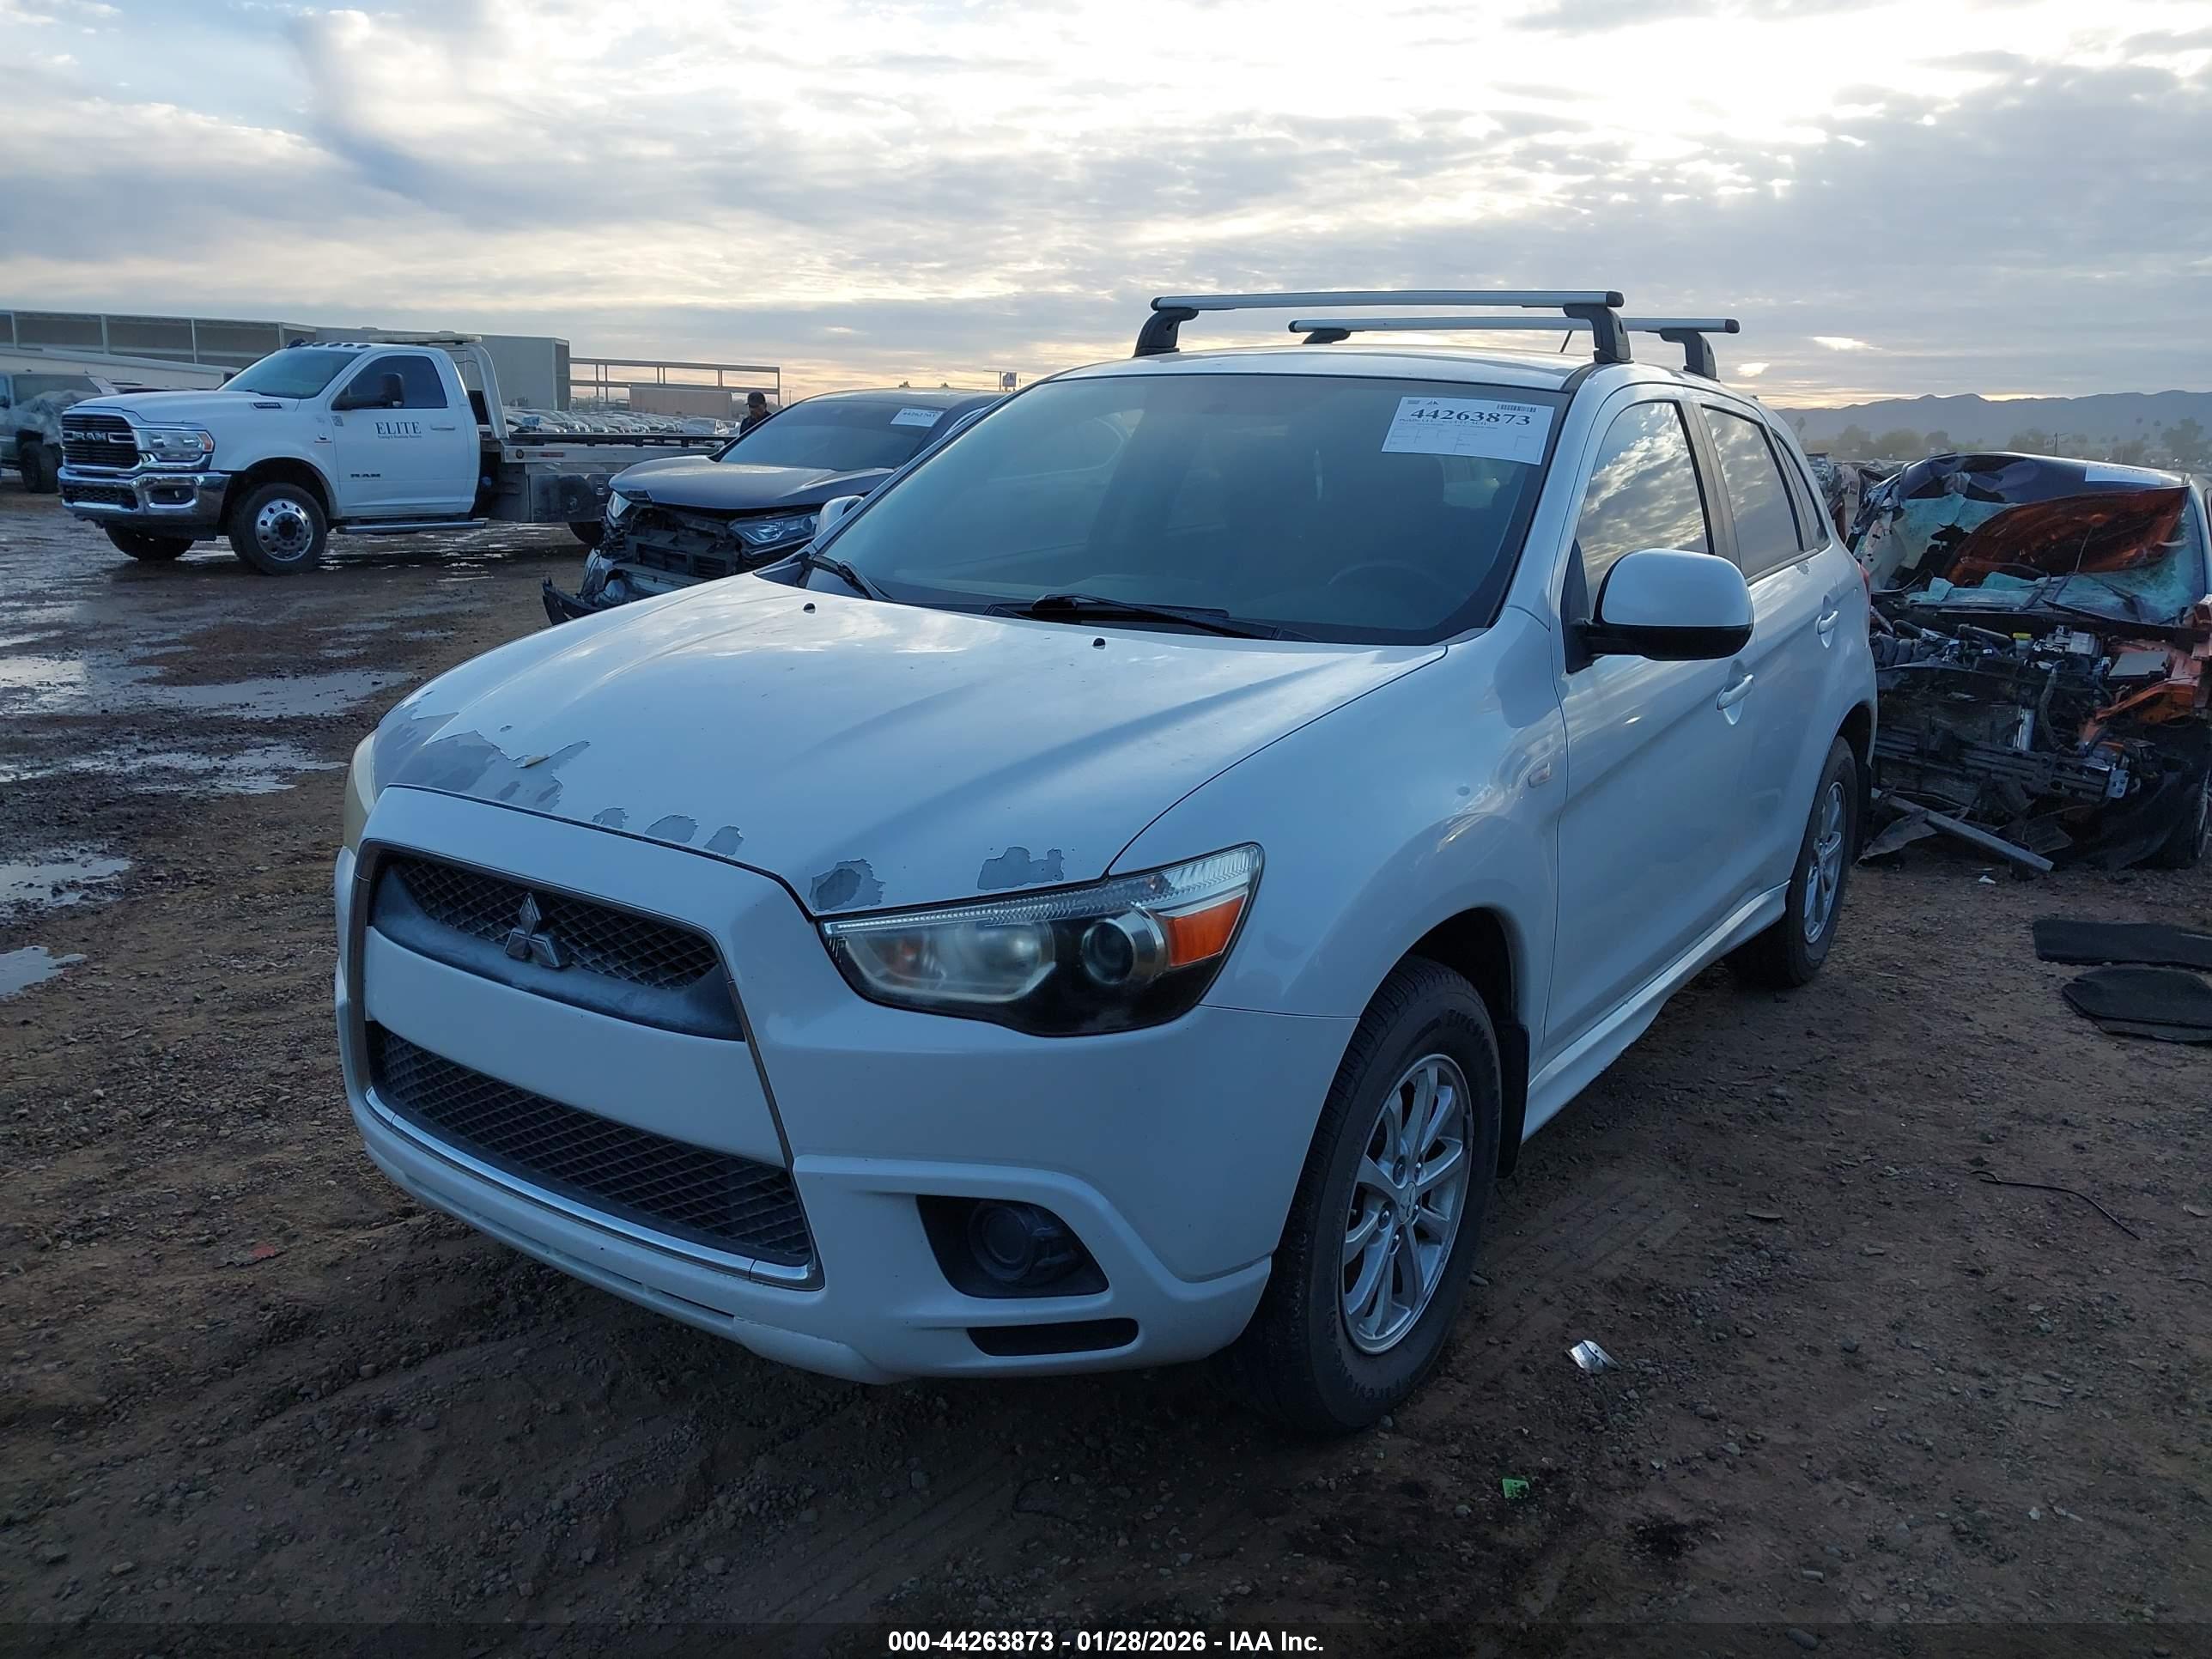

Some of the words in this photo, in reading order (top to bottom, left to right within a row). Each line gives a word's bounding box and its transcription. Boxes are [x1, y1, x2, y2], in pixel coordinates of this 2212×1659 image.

[1410, 408, 1531, 426] 44263873
[375, 422, 422, 434] ELITE
[73, 432, 107, 441] RAM
